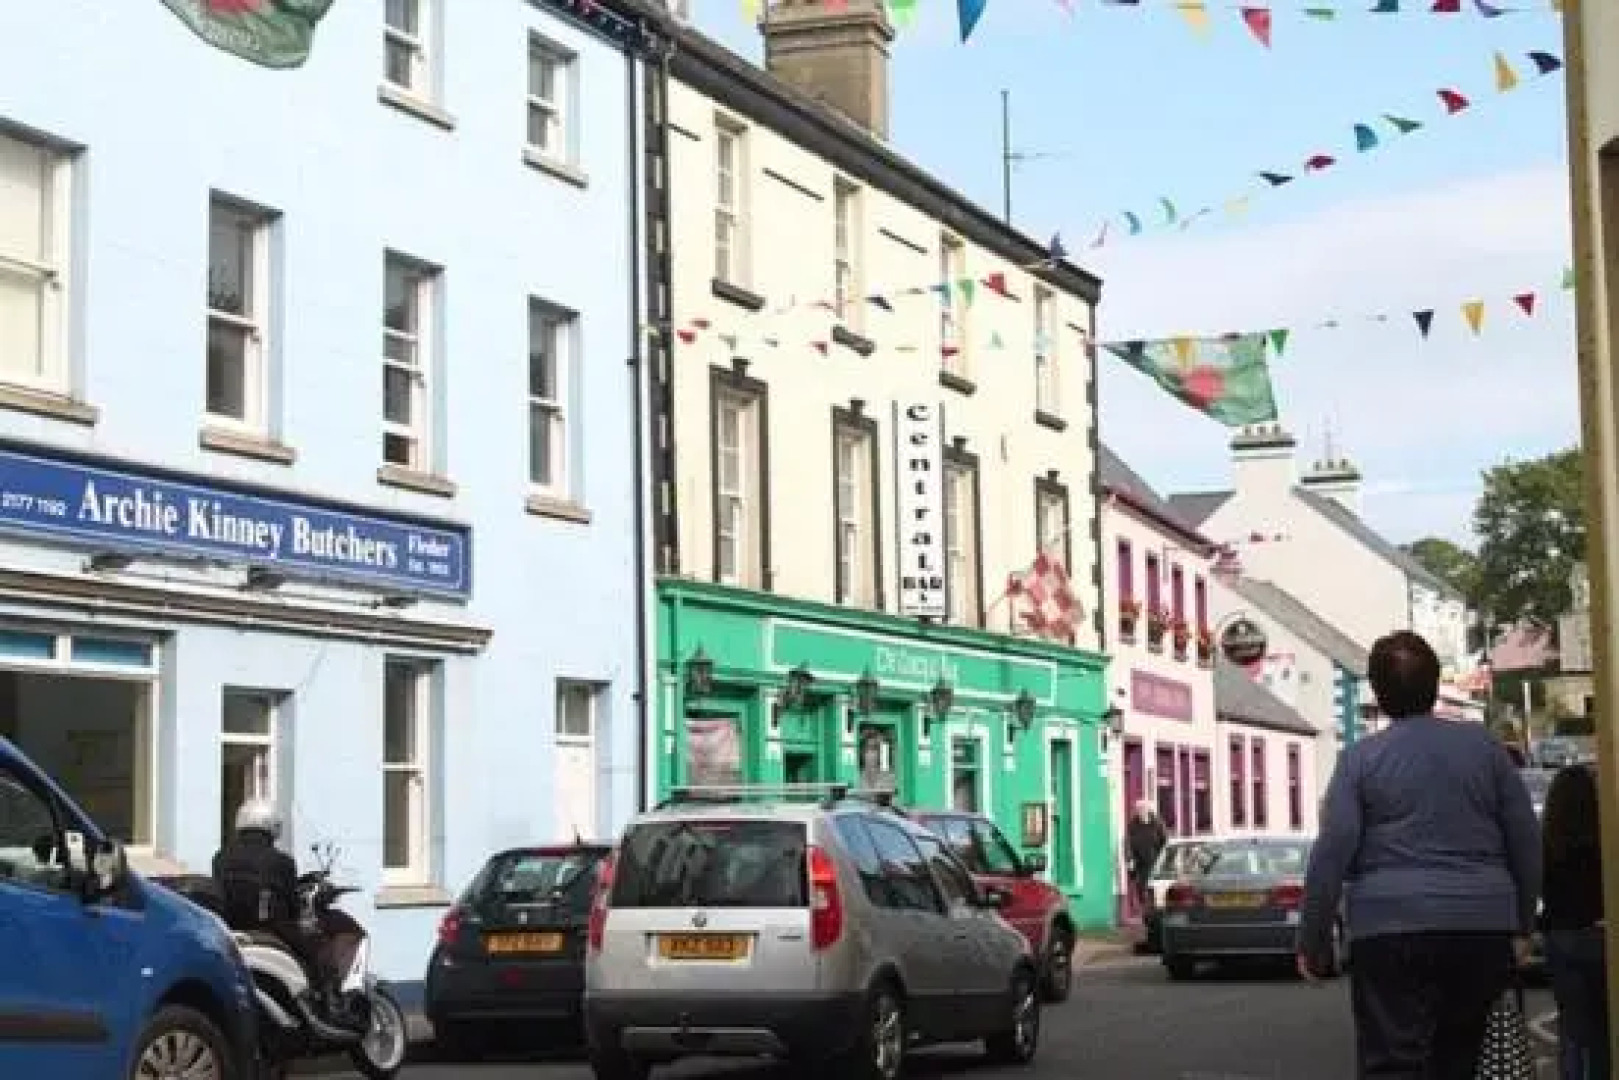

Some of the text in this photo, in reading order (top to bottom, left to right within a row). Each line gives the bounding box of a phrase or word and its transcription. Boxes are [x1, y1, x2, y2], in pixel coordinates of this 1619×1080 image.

[77, 479, 178, 535] Archie
[187, 497, 283, 559] Kinney
[292, 516, 398, 568] Butchers
